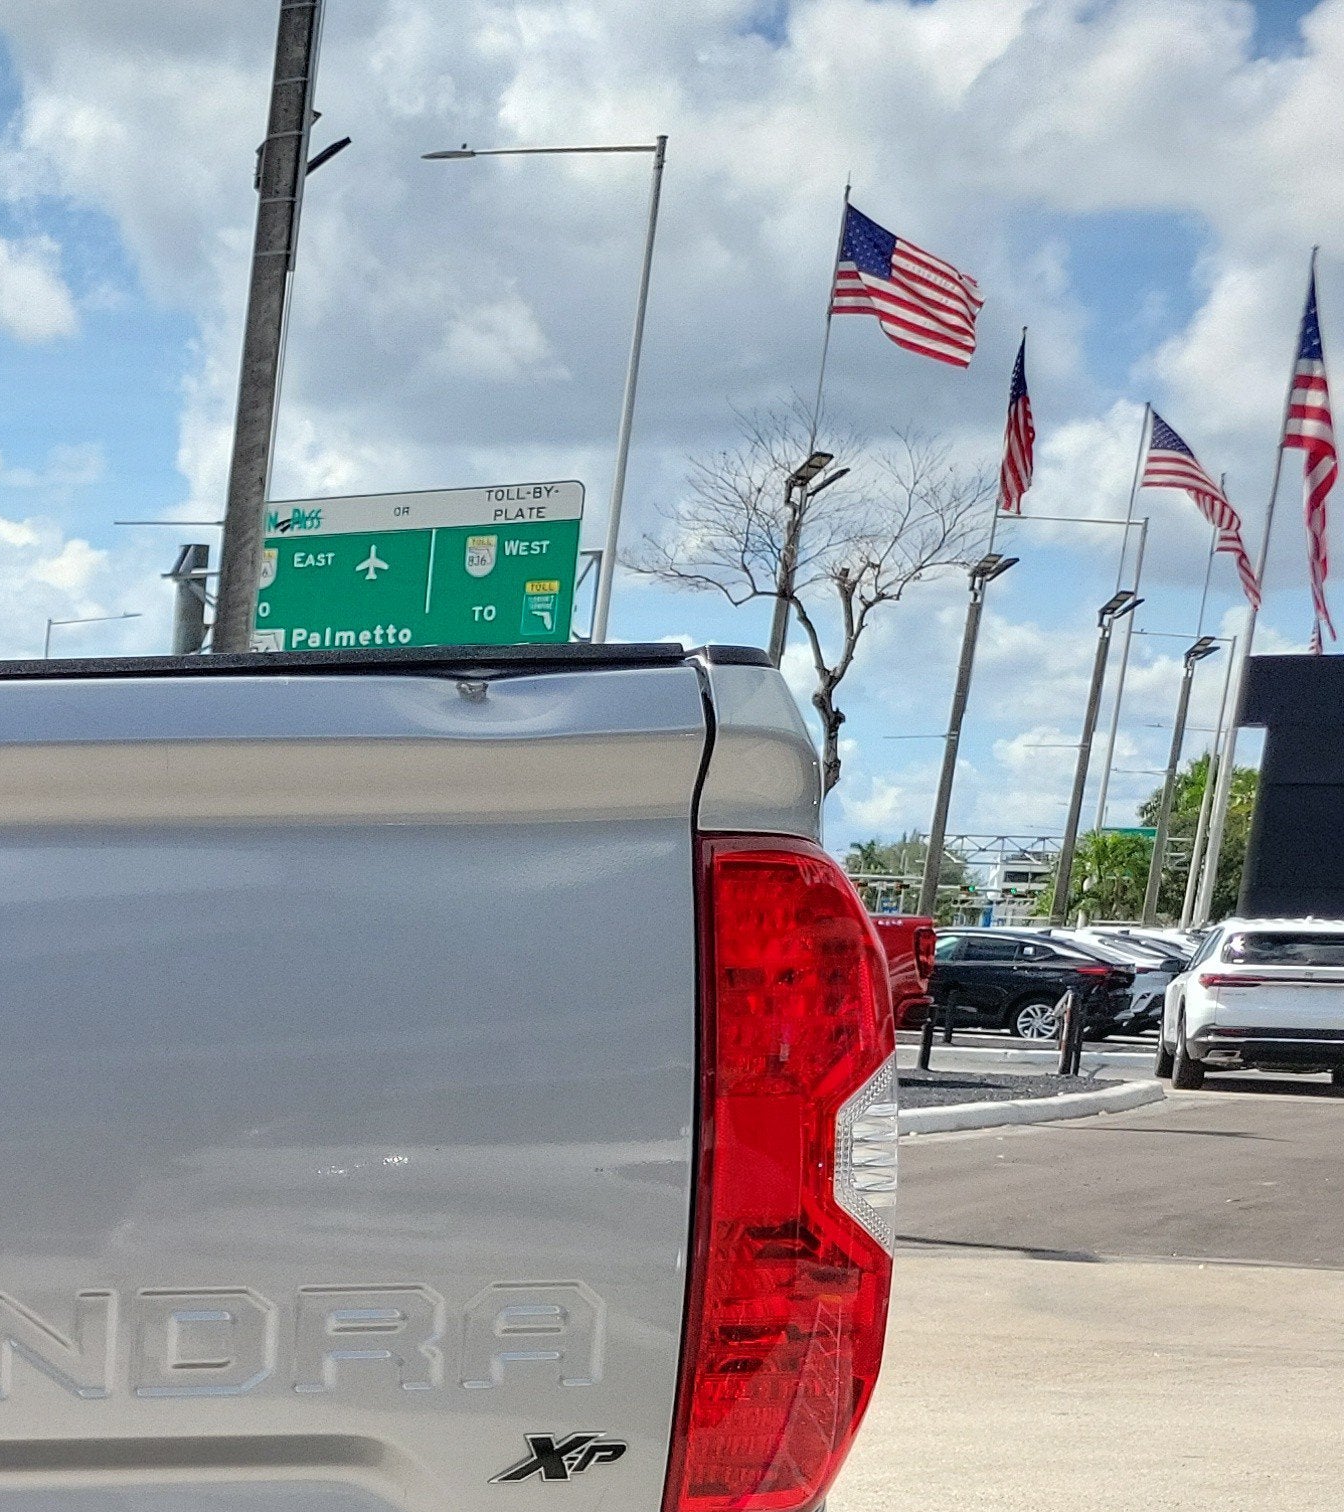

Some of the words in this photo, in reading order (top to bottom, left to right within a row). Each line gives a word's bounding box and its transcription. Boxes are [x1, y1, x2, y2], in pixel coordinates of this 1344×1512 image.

[393, 505, 411, 518] OR
[493, 505, 547, 521] PLATE
[504, 539, 551, 557] WEST
[293, 551, 336, 568] EAST
[529, 582, 556, 592] TOLL
[258, 601, 271, 618] O
[471, 604, 497, 622] TO
[291, 624, 413, 650] Palmetto
